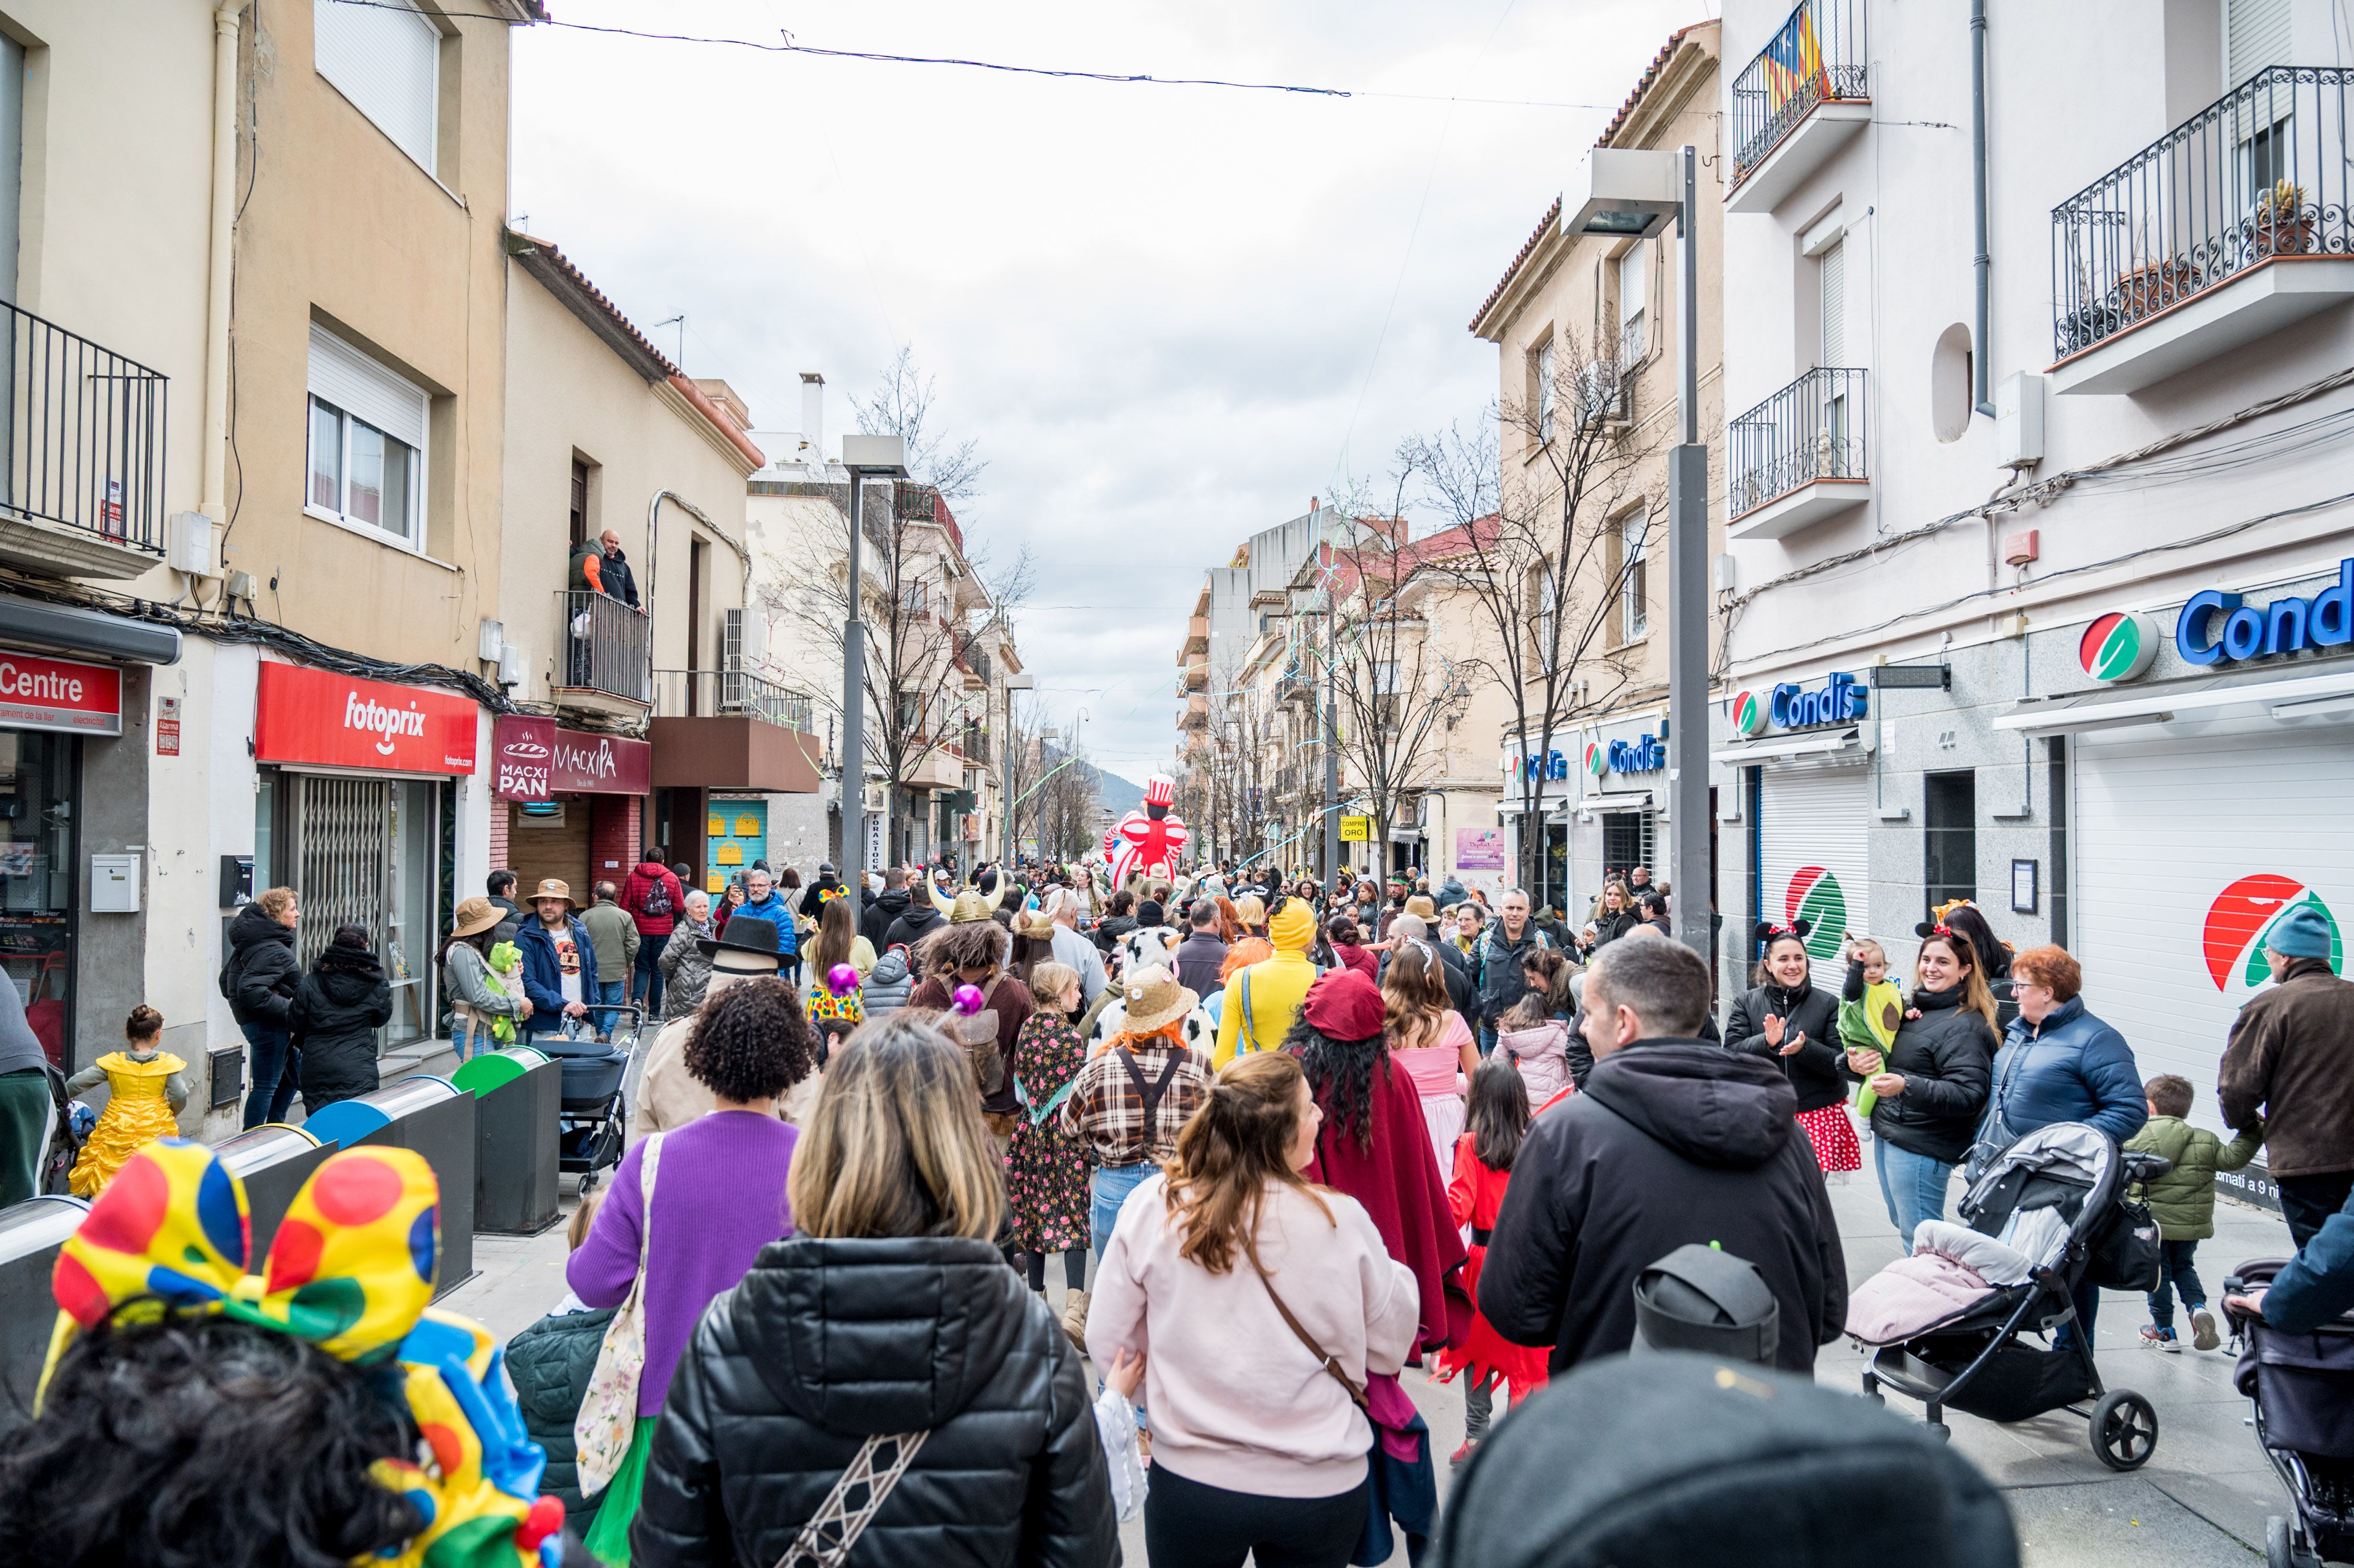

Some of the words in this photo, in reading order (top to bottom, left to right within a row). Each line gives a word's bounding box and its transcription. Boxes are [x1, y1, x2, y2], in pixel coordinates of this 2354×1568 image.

[2176, 558, 2354, 665] Cond
[0, 662, 83, 702] Centre
[1771, 672, 1867, 728] Condis
[0, 709, 23, 718] ament
[25, 710, 34, 720] de
[36, 711, 42, 721] la
[44, 712, 54, 722] llar
[73, 715, 105, 726] electricitat
[160, 721, 178, 730] Alarma
[344, 691, 426, 742] fotoprix
[445, 754, 473, 767] fotoprix.com
[1608, 734, 1665, 773] Condis
[501, 764, 547, 779] MACXI
[1528, 750, 1566, 782] Codis
[499, 776, 546, 796] PAN
[2248, 1180, 2256, 1192] a
[2258, 1180, 2266, 1195] 9
[2269, 1184, 2279, 1199] ni
